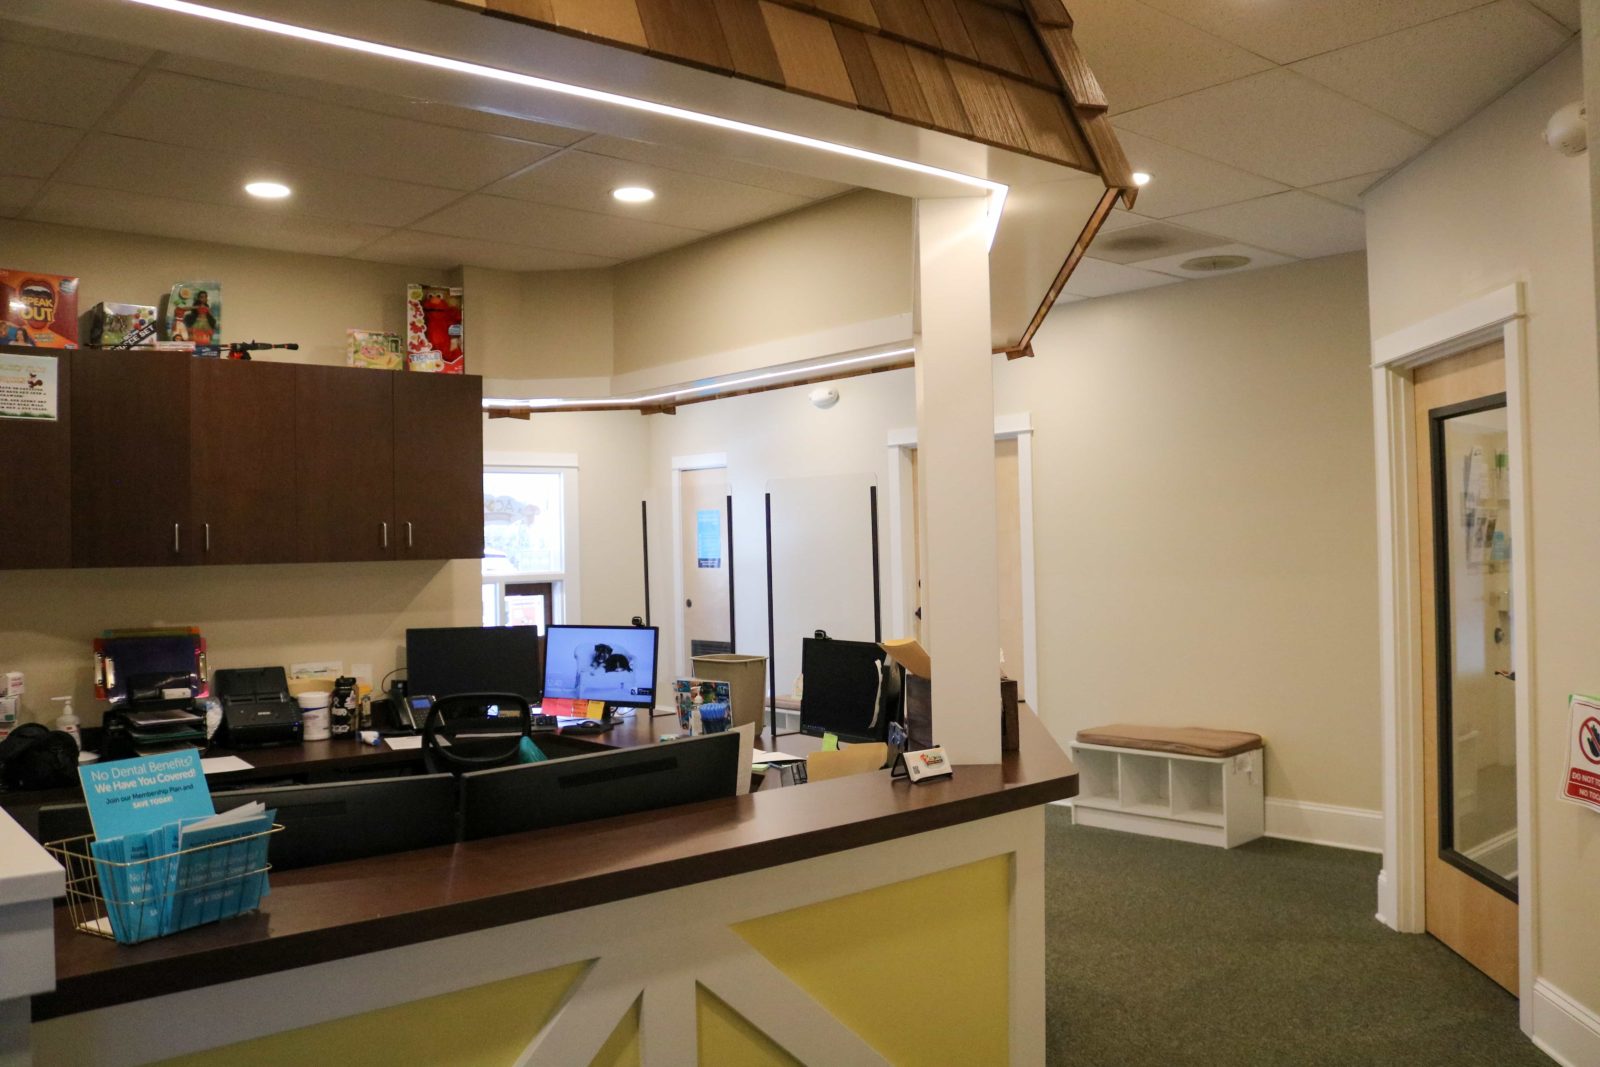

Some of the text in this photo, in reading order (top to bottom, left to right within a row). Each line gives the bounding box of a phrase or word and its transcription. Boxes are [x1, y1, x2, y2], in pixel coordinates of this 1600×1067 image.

[20, 296, 54, 308] SPEAK
[20, 307, 53, 321] OUT
[139, 324, 155, 339] SET
[91, 756, 193, 781] No Dental Benefits?
[95, 768, 196, 793] We Have You Covered!
[1572, 771, 1581, 780] DO
[1582, 775, 1595, 785] NOT
[106, 797, 120, 805] Join
[132, 788, 169, 800] Membership
[169, 785, 181, 793] Plan
[182, 783, 194, 791] and
[1580, 788, 1588, 797] NO
